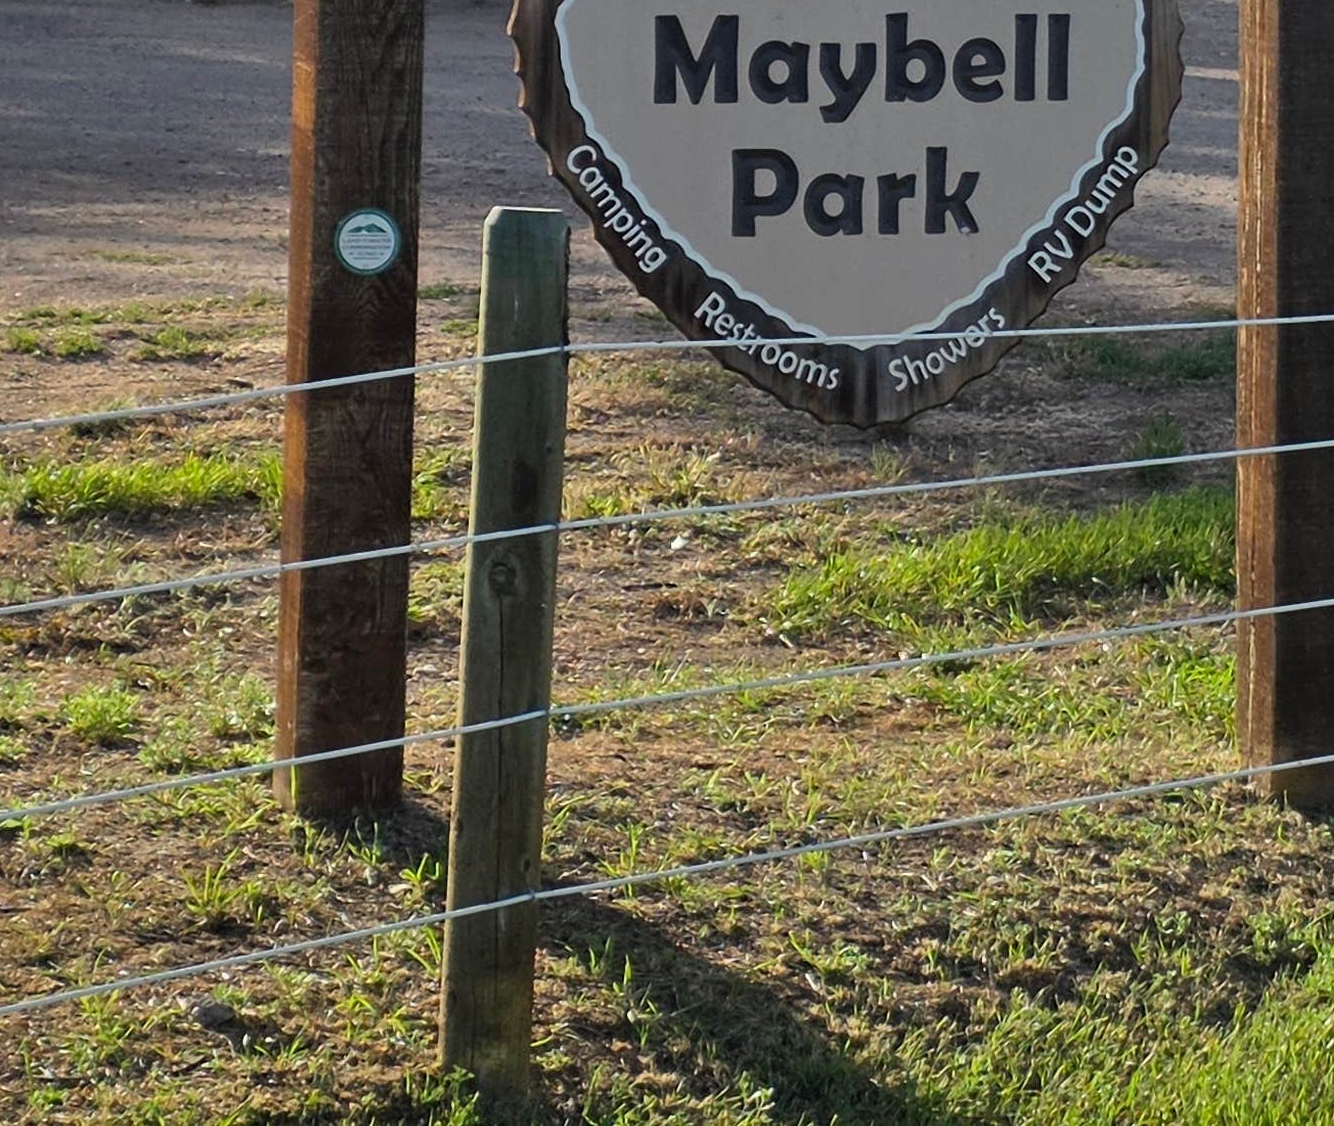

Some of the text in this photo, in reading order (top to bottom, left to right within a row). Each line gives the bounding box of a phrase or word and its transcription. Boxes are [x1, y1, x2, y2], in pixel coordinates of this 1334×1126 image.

[653, 12, 1070, 123] Maybell
[567, 145, 667, 273] Camping
[731, 147, 980, 237] Park
[1027, 146, 1138, 284] RV Dump
[693, 291, 840, 390] Restrooms
[888, 306, 1005, 392] Showers
